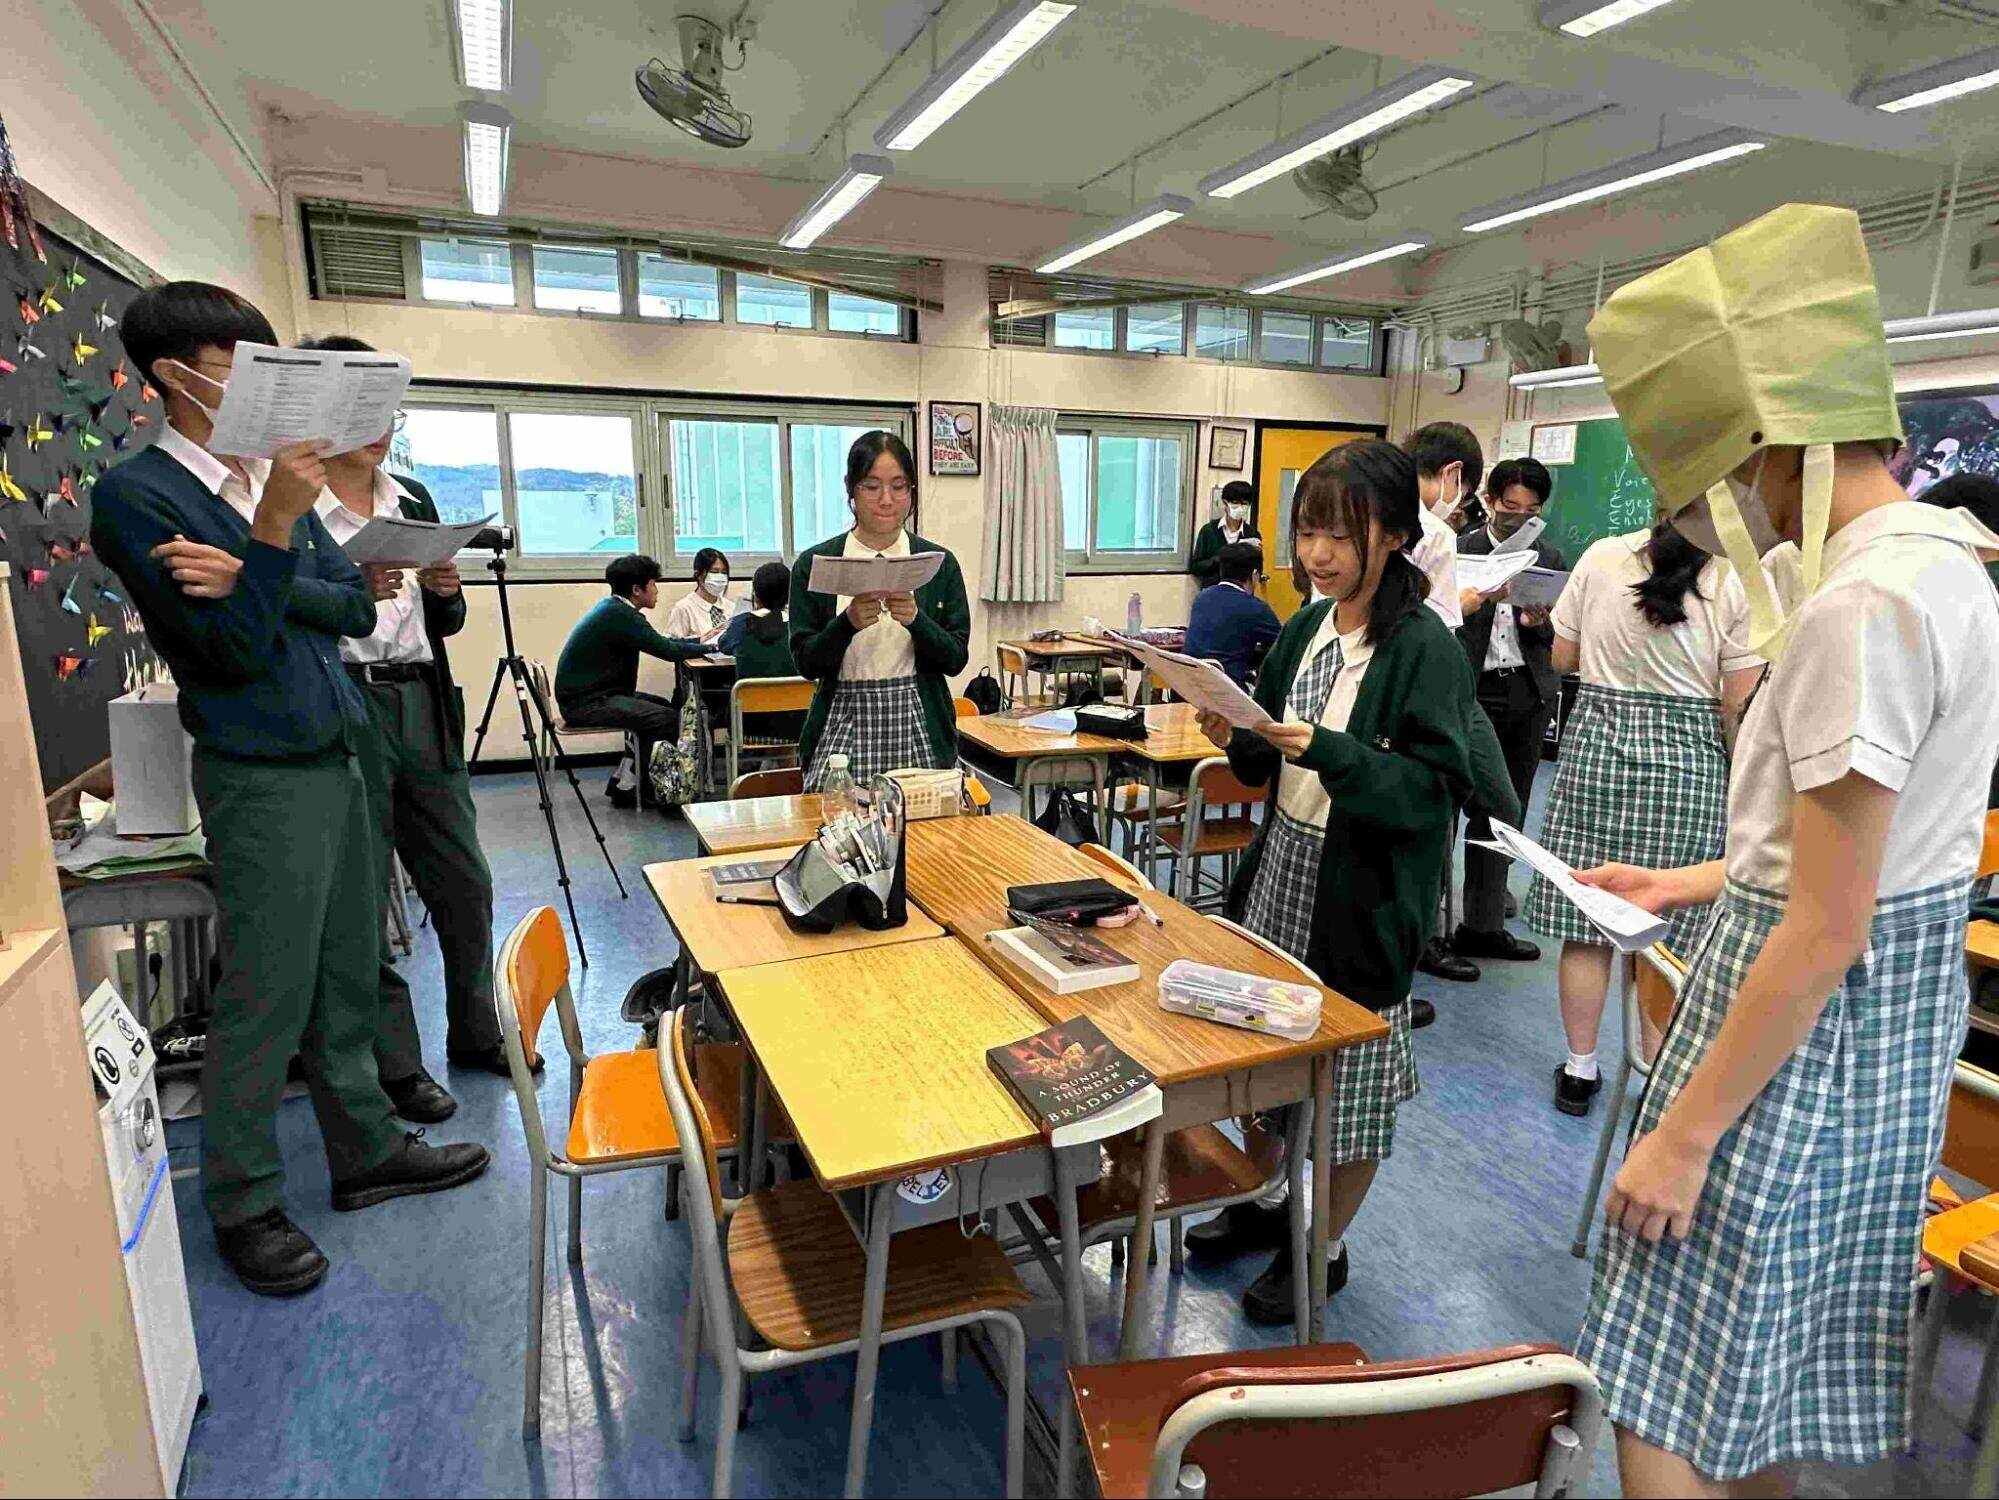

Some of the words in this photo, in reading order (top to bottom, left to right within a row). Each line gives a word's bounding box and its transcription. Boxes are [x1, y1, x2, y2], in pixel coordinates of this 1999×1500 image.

[933, 448, 963, 461] BEFORE
[1038, 1090, 1047, 1098] A
[1052, 1070, 1100, 1092] SOUND
[1104, 1060, 1121, 1072] OF
[1055, 1071, 1120, 1102] THUNDER
[1047, 1071, 1149, 1123] BRADBURY
